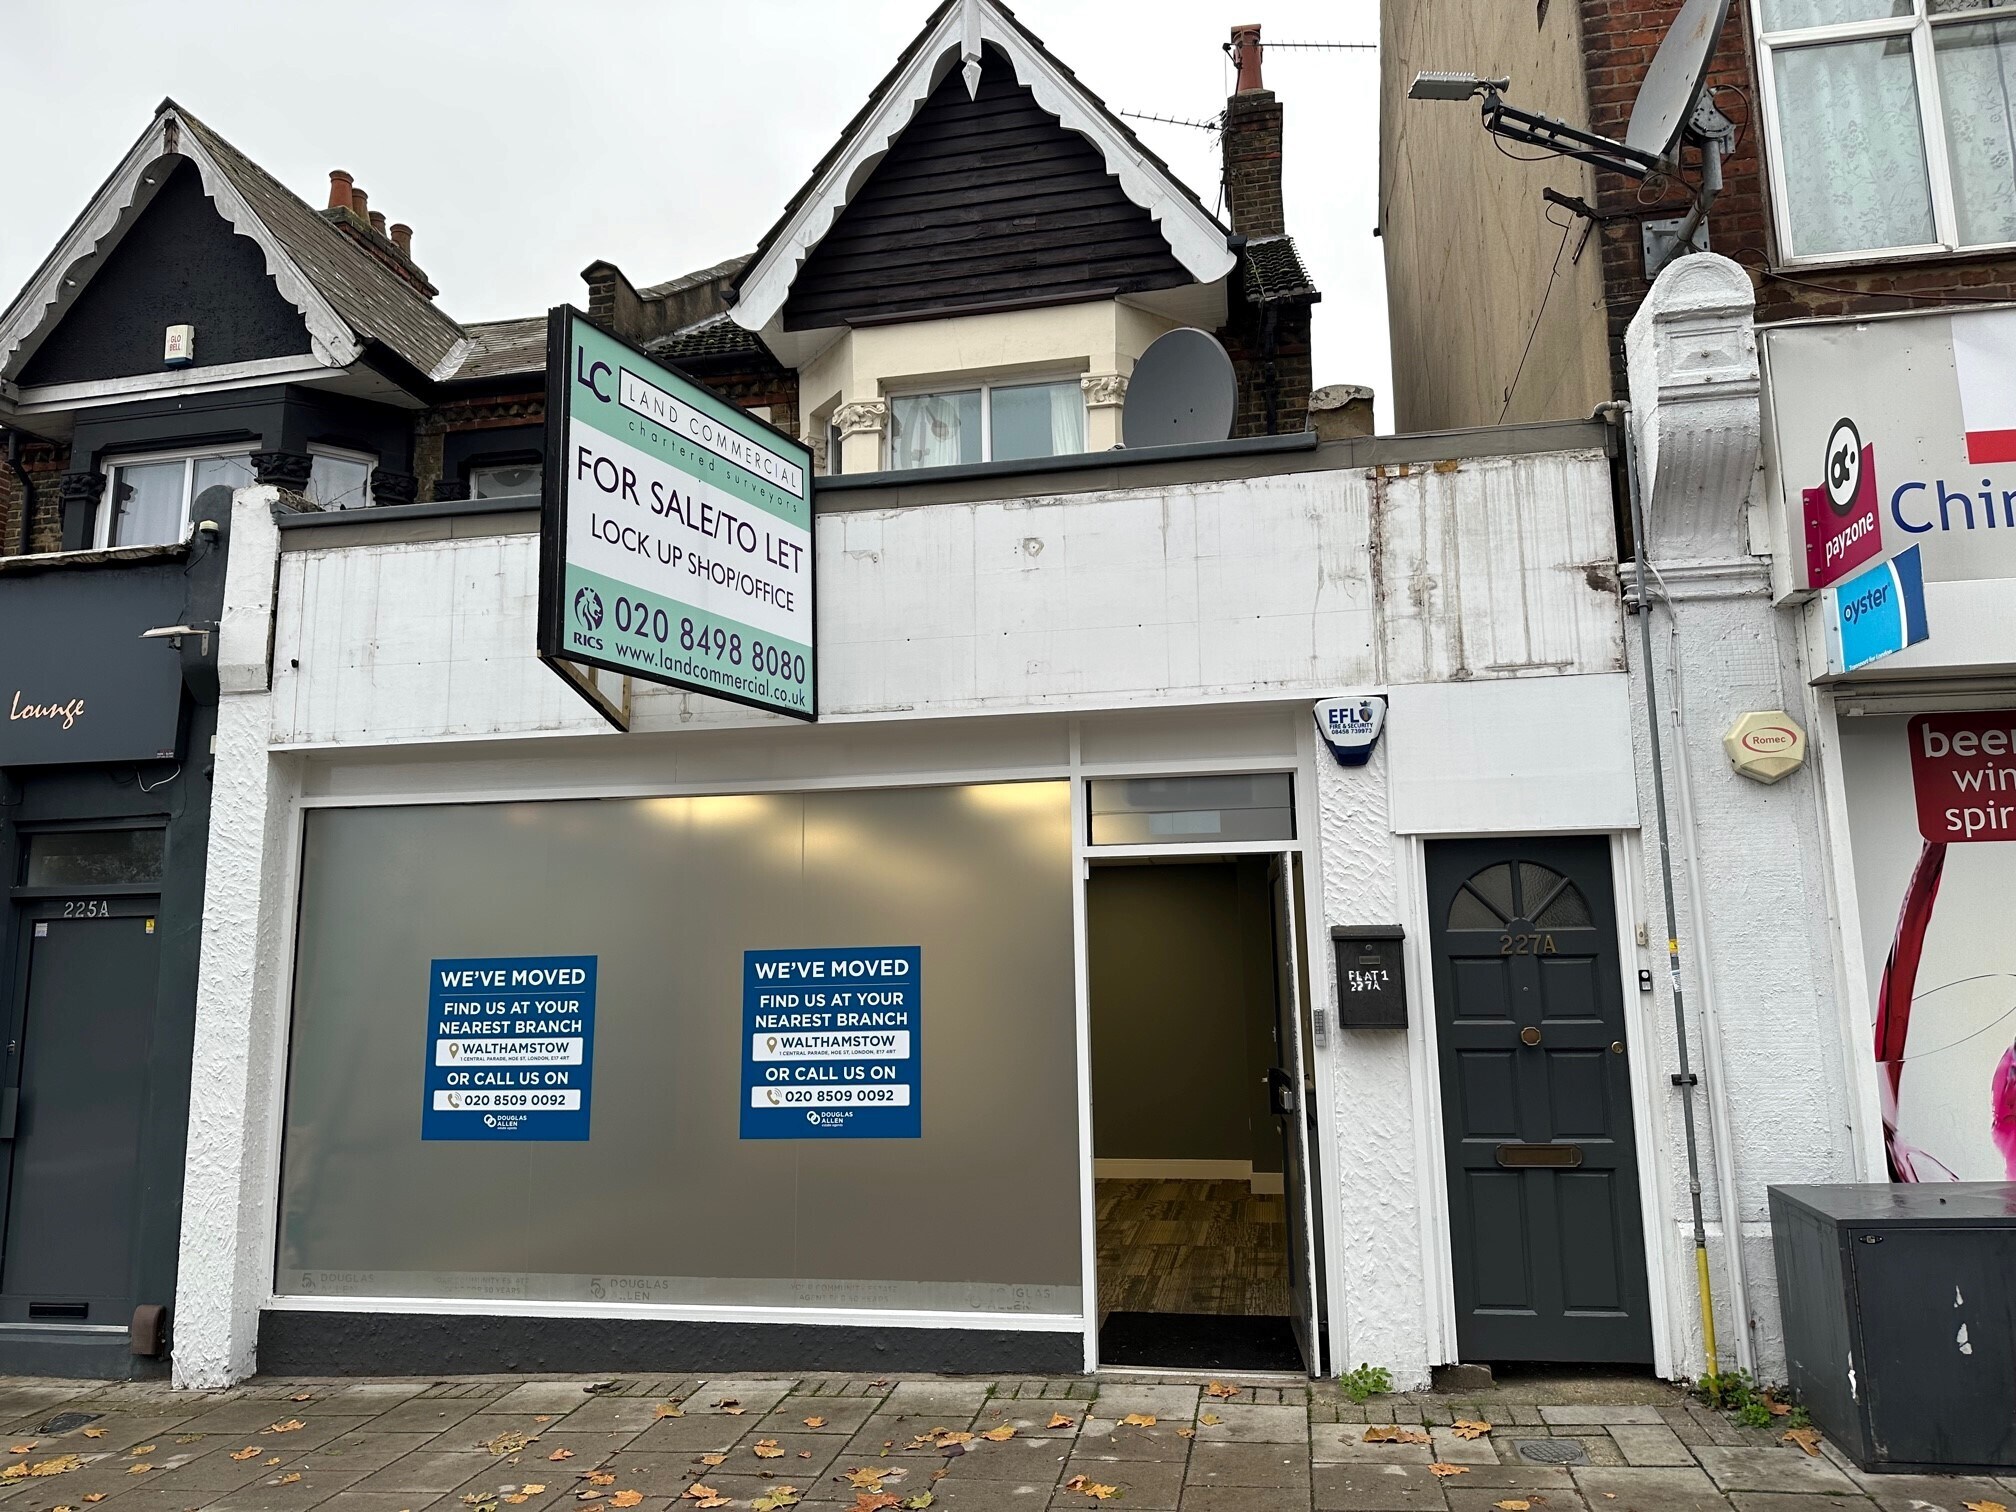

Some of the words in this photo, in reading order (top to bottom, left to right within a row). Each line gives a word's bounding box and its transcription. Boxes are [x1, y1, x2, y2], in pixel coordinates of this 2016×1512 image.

[629, 383, 678, 423] LAND
[689, 417, 797, 488] COMMERCIAL
[628, 421, 715, 471] chartered
[726, 471, 797, 513] surveyors
[577, 445, 640, 507] FOR
[650, 480, 757, 553] SALE/TO
[766, 532, 803, 574] LET
[1825, 511, 1874, 568] payzone
[591, 513, 651, 559] LOCK
[657, 539, 683, 568] UP
[688, 552, 795, 613] SHOP/OFFICE
[1844, 585, 1888, 625] oyster
[573, 631, 604, 651] RICS
[614, 596, 669, 643] 020
[680, 617, 742, 666] 8498
[752, 640, 806, 685] 8080
[615, 642, 806, 707] www.landcommercial.co.uk
[10, 690, 85, 730] Lounge
[1329, 708, 1360, 724] EFL
[1752, 735, 1786, 745] Romec
[63, 900, 110, 918] 225A
[1500, 934, 1558, 955] 227A
[831, 959, 909, 977] MOVED
[1348, 970, 1379, 981] FLAT
[512, 969, 586, 986] MOVED
[1350, 980, 1381, 992] 227A
[760, 995, 799, 1008] FIND
[804, 994, 826, 1007] US
[830, 993, 852, 1007] AT
[857, 992, 904, 1006] YOUR
[444, 1002, 481, 1016] FIND
[485, 1002, 506, 1015] US
[510, 1002, 530, 1014] AT
[534, 1001, 579, 1014] YOUR
[439, 1021, 511, 1035] NEAREST
[515, 1020, 582, 1034] BRANCH
[755, 1014, 832, 1028] NEAREST
[837, 1012, 908, 1027] BRANCH
[462, 1042, 570, 1054] WALTHAMSTOW
[781, 1035, 895, 1048] WALTHAMSTOW
[447, 1073, 469, 1086] OR
[474, 1072, 514, 1085] CALL
[519, 1072, 540, 1085] US
[544, 1072, 568, 1085] ON
[765, 1067, 790, 1081] OR
[795, 1067, 839, 1081] CALL
[843, 1066, 865, 1080] US
[870, 1066, 896, 1080] ON
[464, 1095, 490, 1106] 020
[493, 1095, 527, 1106] 8509
[531, 1095, 566, 1105] 0092
[785, 1091, 812, 1102] 020
[817, 1091, 852, 1102] 8509
[857, 1090, 894, 1101] 0092
[610, 1279, 669, 1289] DOUGLAS
